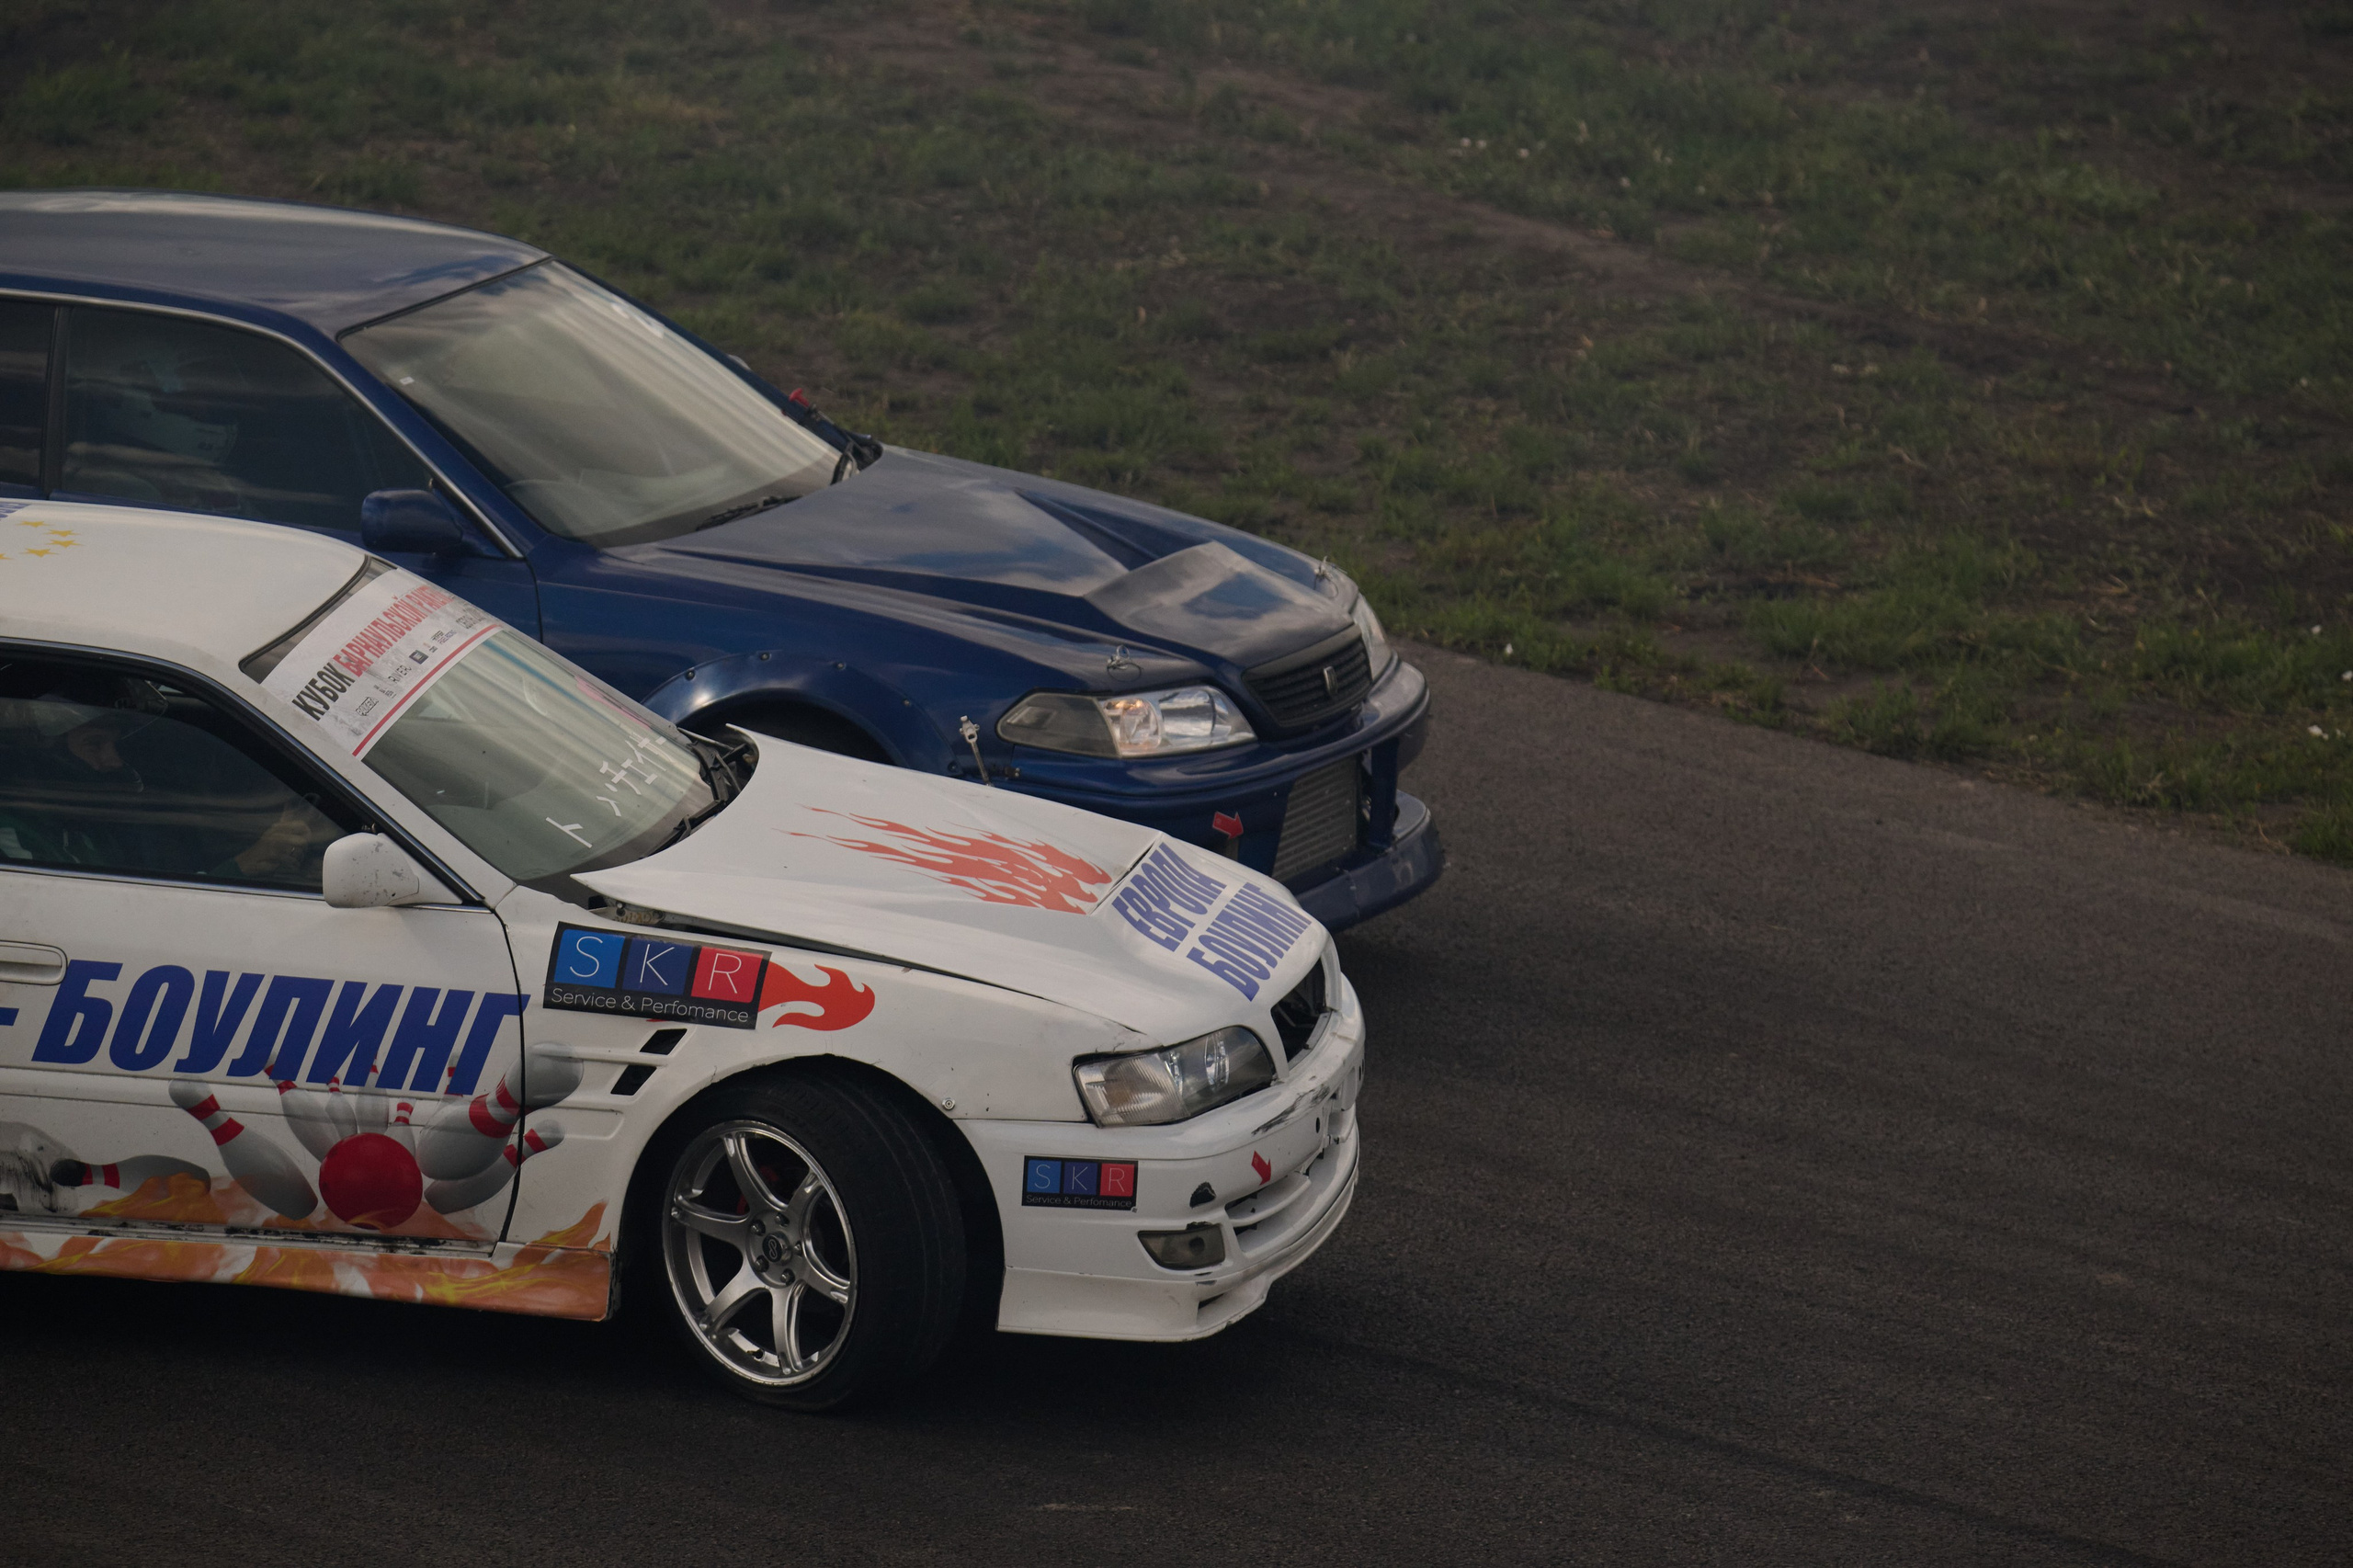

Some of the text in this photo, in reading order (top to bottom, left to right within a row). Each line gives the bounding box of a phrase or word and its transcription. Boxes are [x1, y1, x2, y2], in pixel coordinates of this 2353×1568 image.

[292, 662, 355, 722] КУБОК
[333, 596, 428, 677] БАРНАУЛЬСКОЙ
[1111, 842, 1227, 952] ЕВРОПА
[1187, 881, 1312, 1002] БОУЛИНГ
[31, 960, 531, 1096] БОУЛИНГ
[551, 988, 749, 1023] Service & Perfomance
[1027, 1195, 1132, 1208] Service & Perfomance
